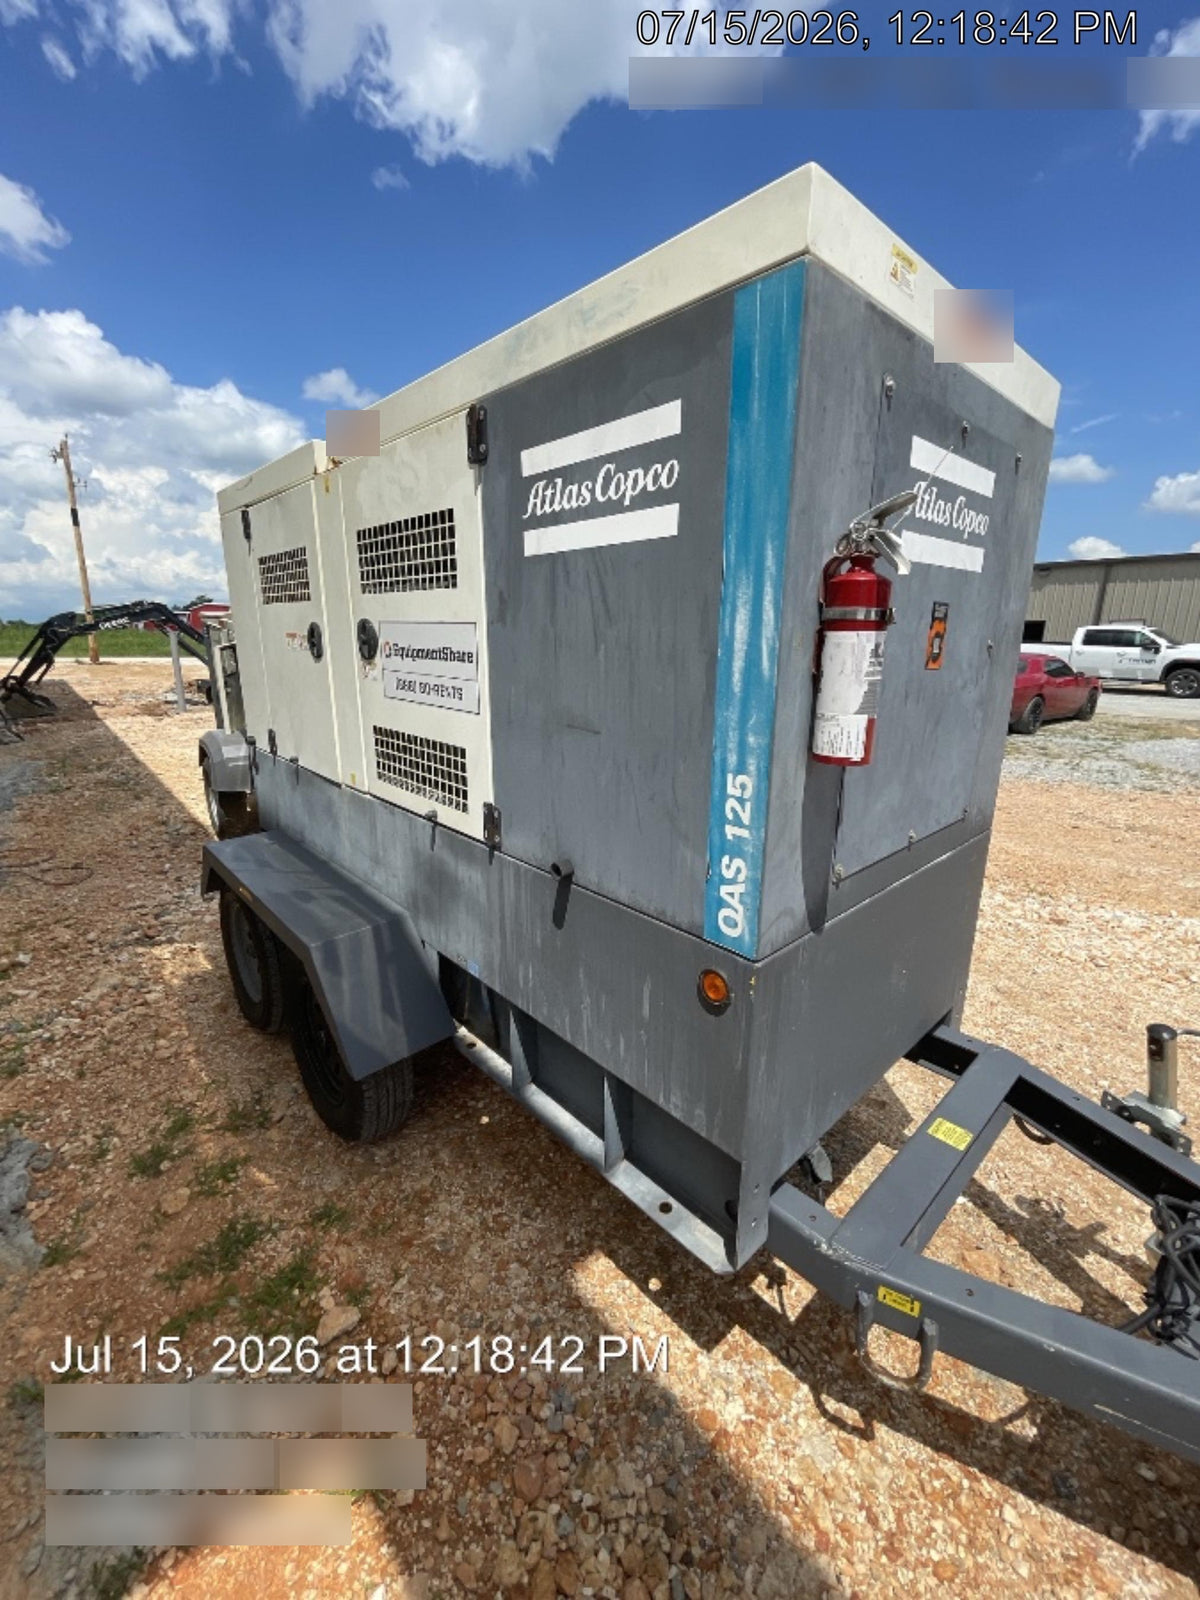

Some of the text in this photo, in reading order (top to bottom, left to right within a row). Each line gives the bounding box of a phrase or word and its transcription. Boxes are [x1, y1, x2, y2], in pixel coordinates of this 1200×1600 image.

[522, 459, 680, 519] Atlas Copco
[912, 481, 990, 540] Atlas Copco
[717, 772, 753, 938] QAS 125
